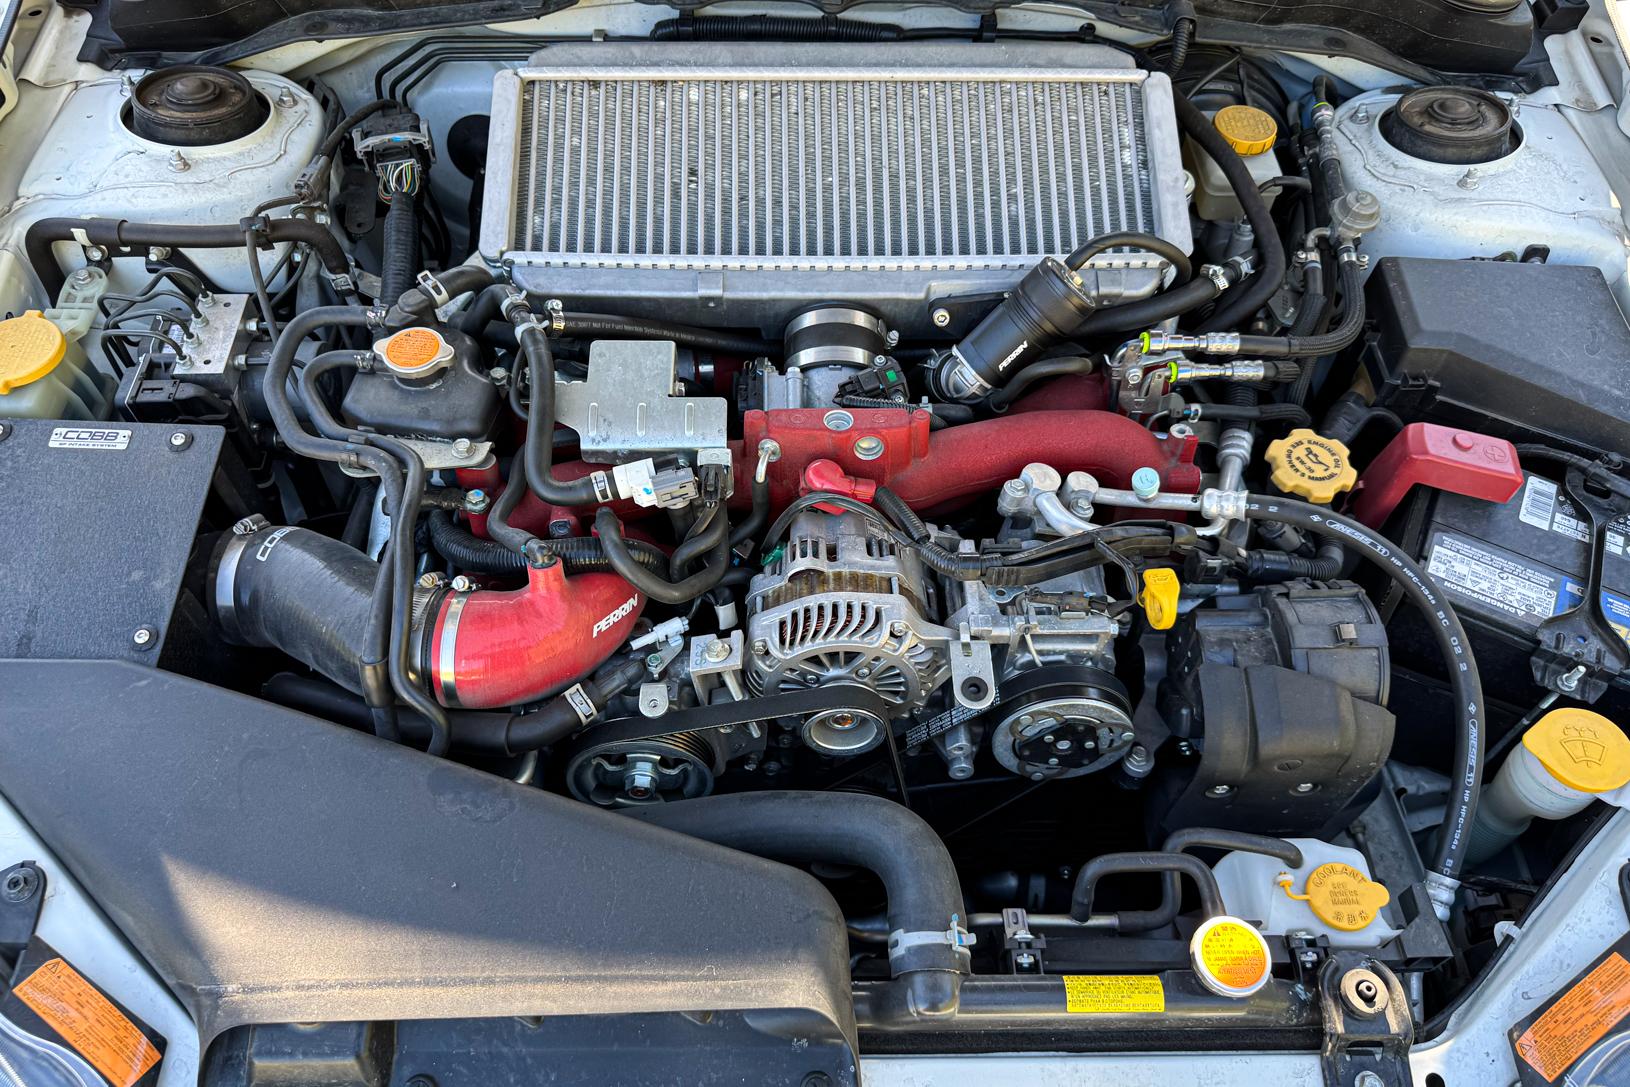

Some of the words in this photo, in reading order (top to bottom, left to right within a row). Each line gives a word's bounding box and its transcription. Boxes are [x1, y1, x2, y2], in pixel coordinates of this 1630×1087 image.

[998, 340, 1028, 372] PERRIN
[62, 430, 120, 441] COBB
[592, 594, 638, 638] PERRIN
[1390, 556, 1402, 567] HP
[1436, 610, 1450, 627] BC
[1459, 662, 1468, 672] 2
[1463, 789, 1470, 802] HP
[1312, 864, 1367, 888] COOLANT
[1442, 858, 1454, 876] BC
